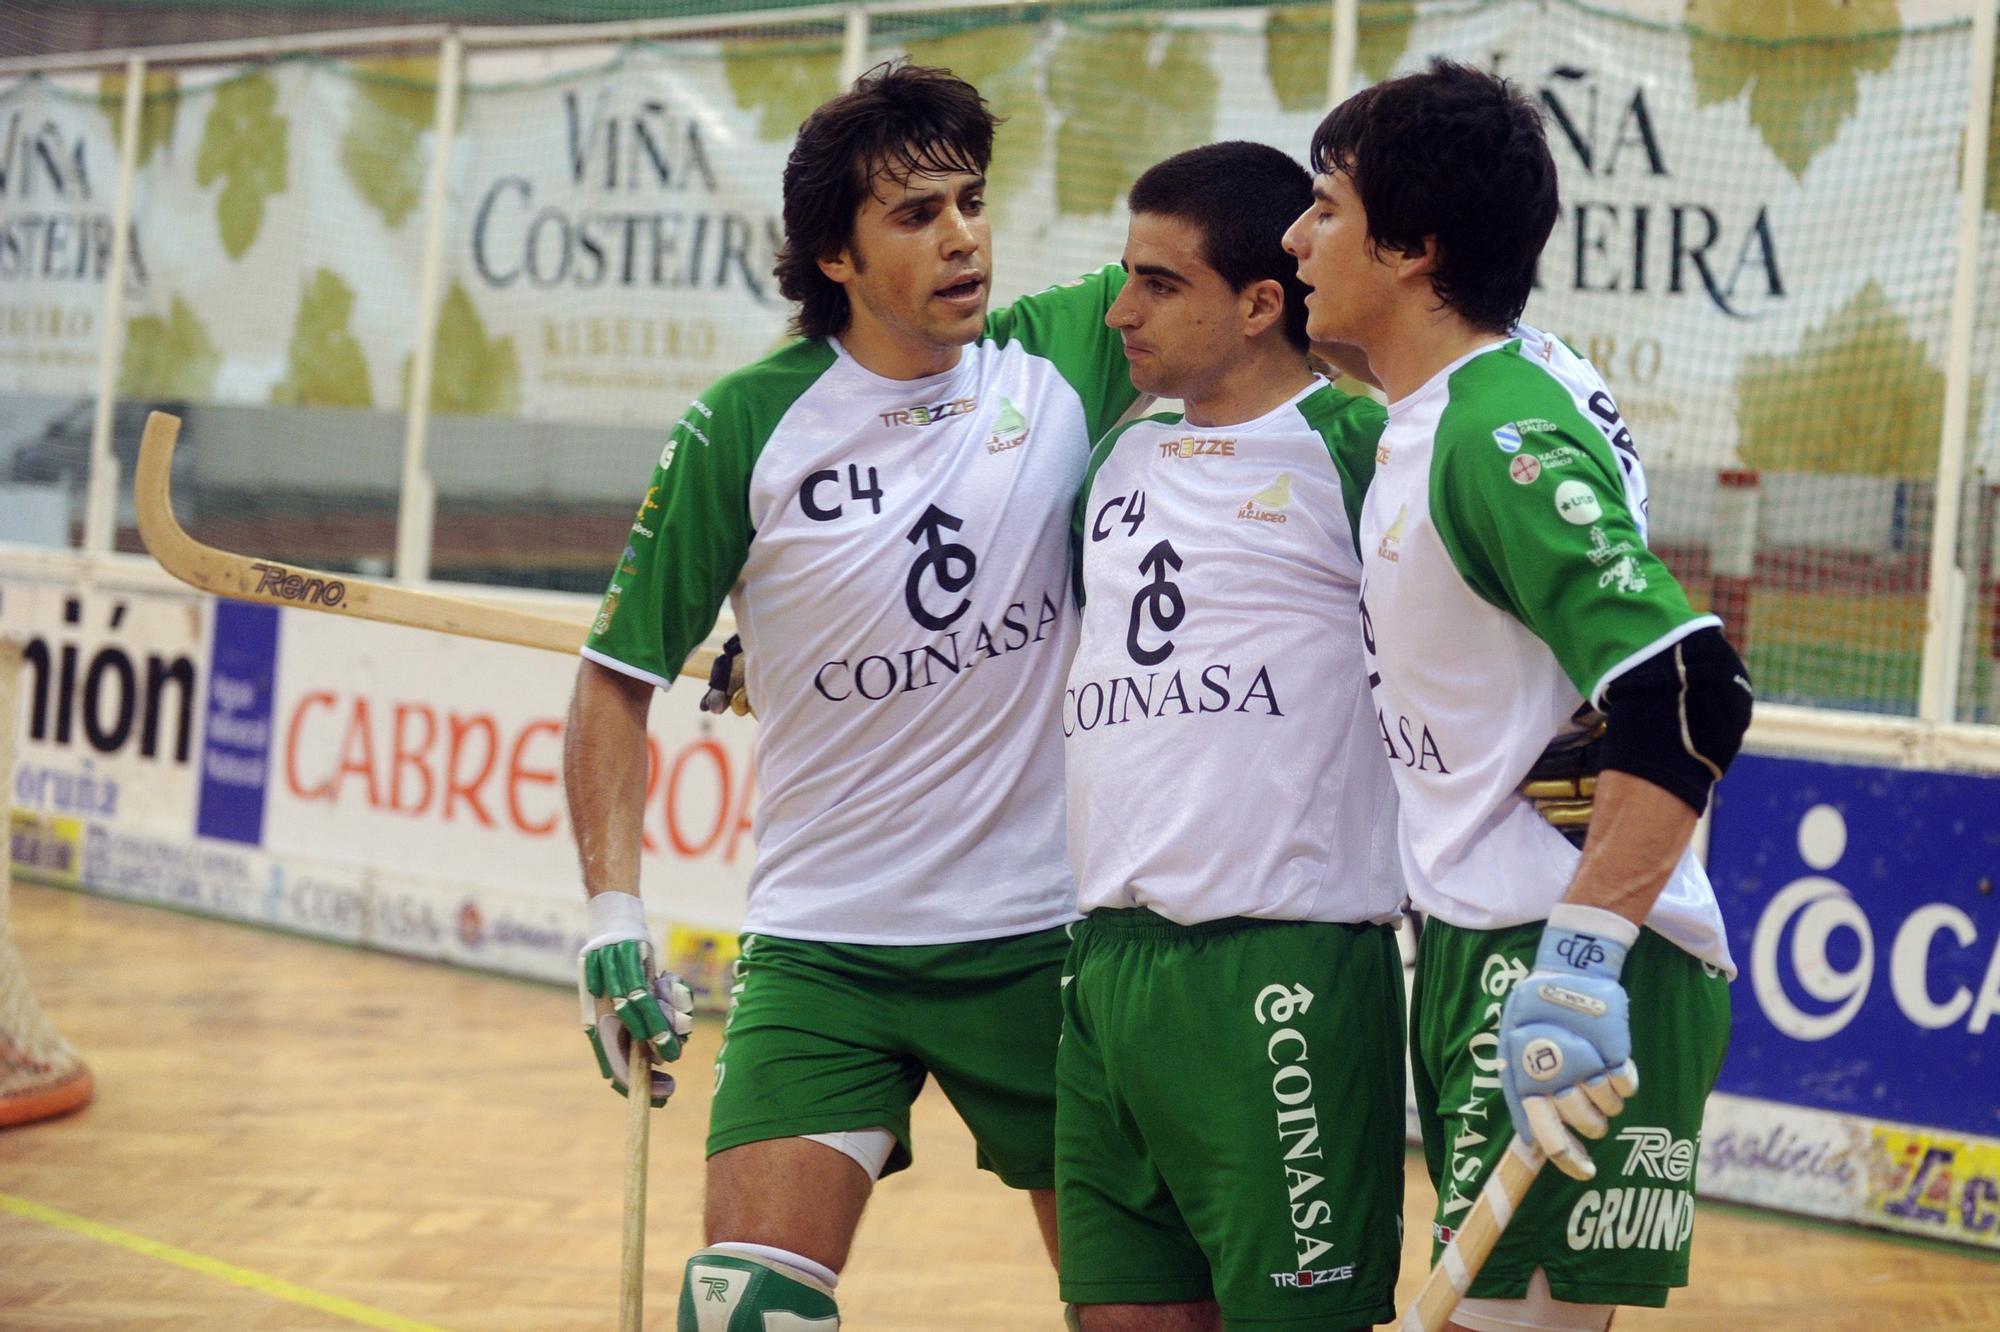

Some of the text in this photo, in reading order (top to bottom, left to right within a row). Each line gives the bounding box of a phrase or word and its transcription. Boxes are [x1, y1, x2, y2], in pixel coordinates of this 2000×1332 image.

[563, 88, 718, 193] VIÑA
[799, 463, 884, 522] C4
[1092, 489, 1147, 543] C4
[814, 591, 1058, 702] COINASA
[1062, 663, 1285, 738] COINASA
[1268, 1027, 1334, 1271] COINASA
[1270, 1265, 1353, 1289] TRZZE
